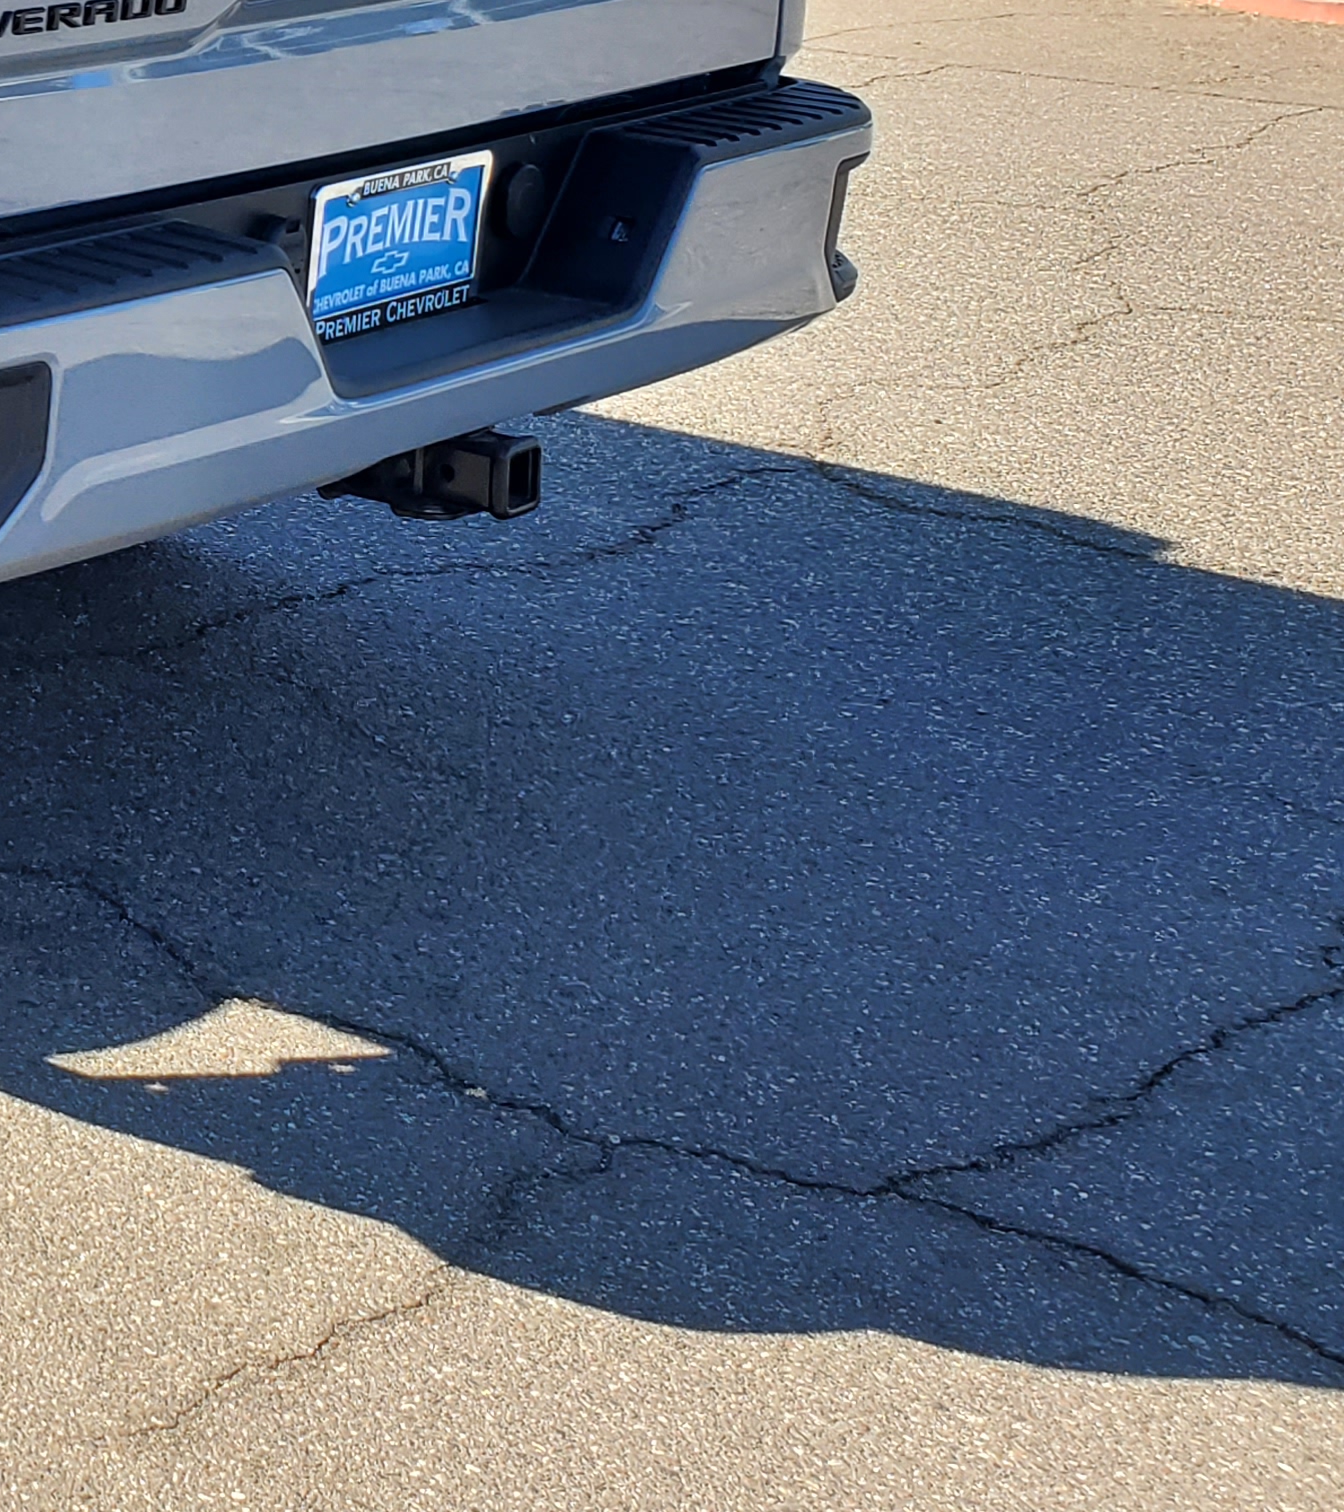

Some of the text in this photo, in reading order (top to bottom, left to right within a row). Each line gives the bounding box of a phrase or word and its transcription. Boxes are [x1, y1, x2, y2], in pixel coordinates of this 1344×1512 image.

[363, 175, 400, 196] BUENA
[434, 165, 449, 179] CA
[319, 188, 472, 278] PREMIER
[366, 279, 379, 297] of
[379, 272, 416, 293] BUENA
[418, 263, 451, 285] PARK,
[454, 259, 470, 274] CA
[316, 285, 470, 340] PREMIER CHEVROLET
